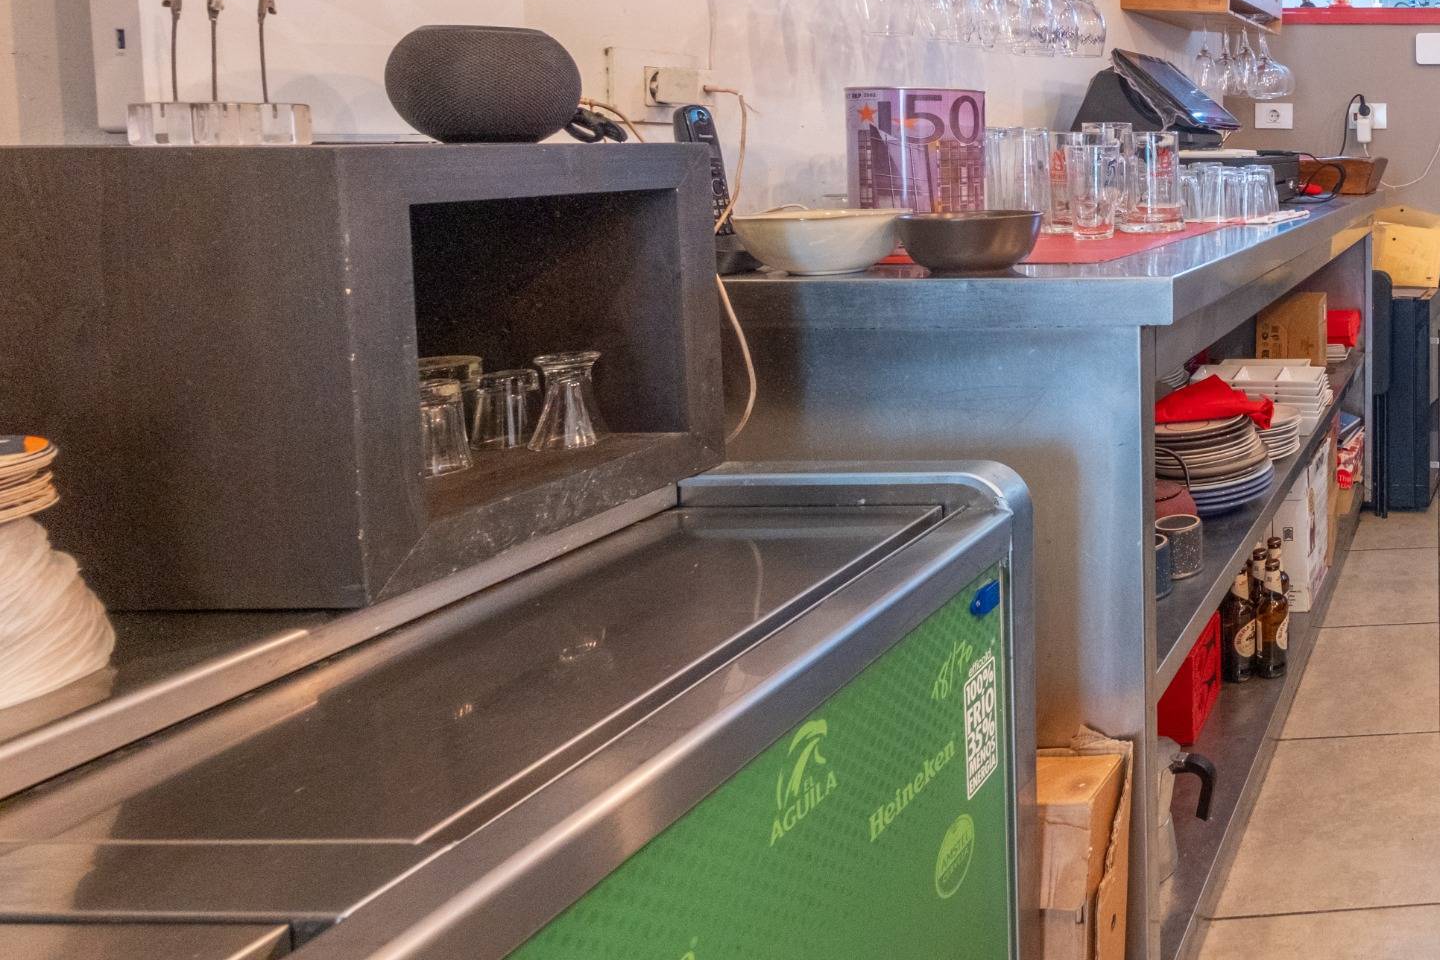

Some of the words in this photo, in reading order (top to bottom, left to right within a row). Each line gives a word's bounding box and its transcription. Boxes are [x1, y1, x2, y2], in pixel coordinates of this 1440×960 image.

[905, 94, 985, 145] 50
[966, 664, 994, 706] 100%
[968, 713, 995, 760] 35%
[968, 737, 996, 776] MENOS
[770, 770, 838, 848] AGUILA
[868, 740, 955, 842] Heineken
